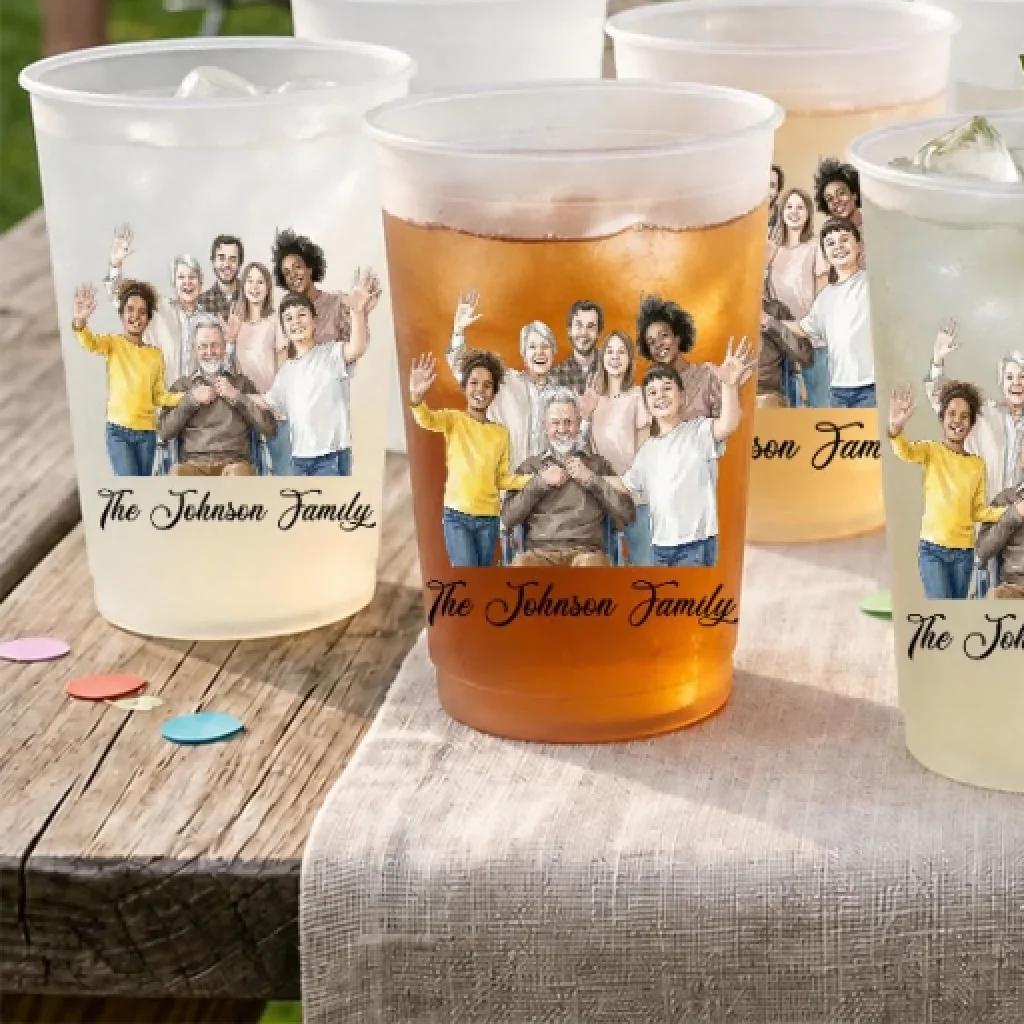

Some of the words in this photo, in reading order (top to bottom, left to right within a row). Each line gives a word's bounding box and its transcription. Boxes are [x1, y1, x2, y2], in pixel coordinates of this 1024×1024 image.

[810, 421, 882, 471] Fam
[97, 488, 141, 531] The
[149, 488, 268, 531] Johnson
[277, 488, 377, 532] Family
[425, 579, 474, 627] The
[485, 579, 618, 627] Johnson
[627, 579, 739, 627] Family
[906, 613, 953, 661] The
